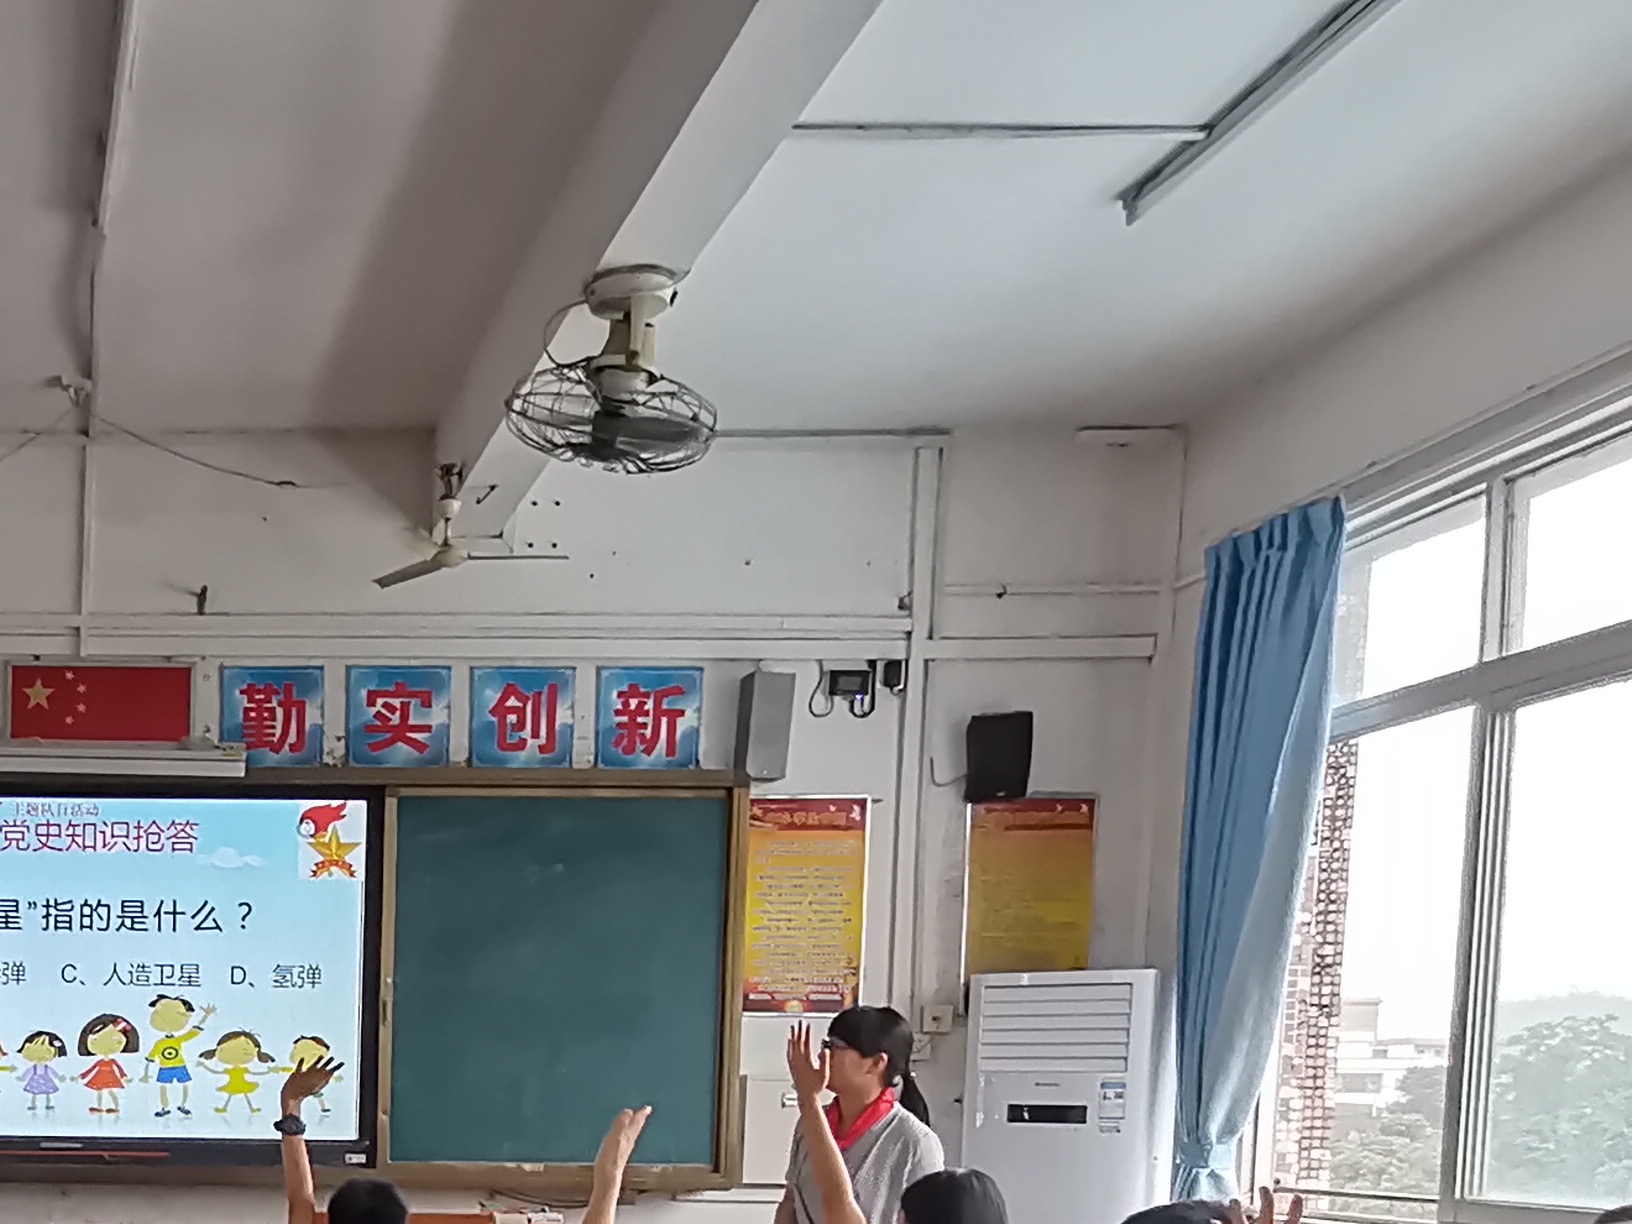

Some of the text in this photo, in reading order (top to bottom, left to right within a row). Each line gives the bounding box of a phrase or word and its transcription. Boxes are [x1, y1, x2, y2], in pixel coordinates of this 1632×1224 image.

[239, 681, 686, 758] 勤实创新
[0, 819, 200, 853] 党史知识抢答
[61, 961, 202, 988] C、人造卫星
[230, 963, 323, 989] D、氢弹
